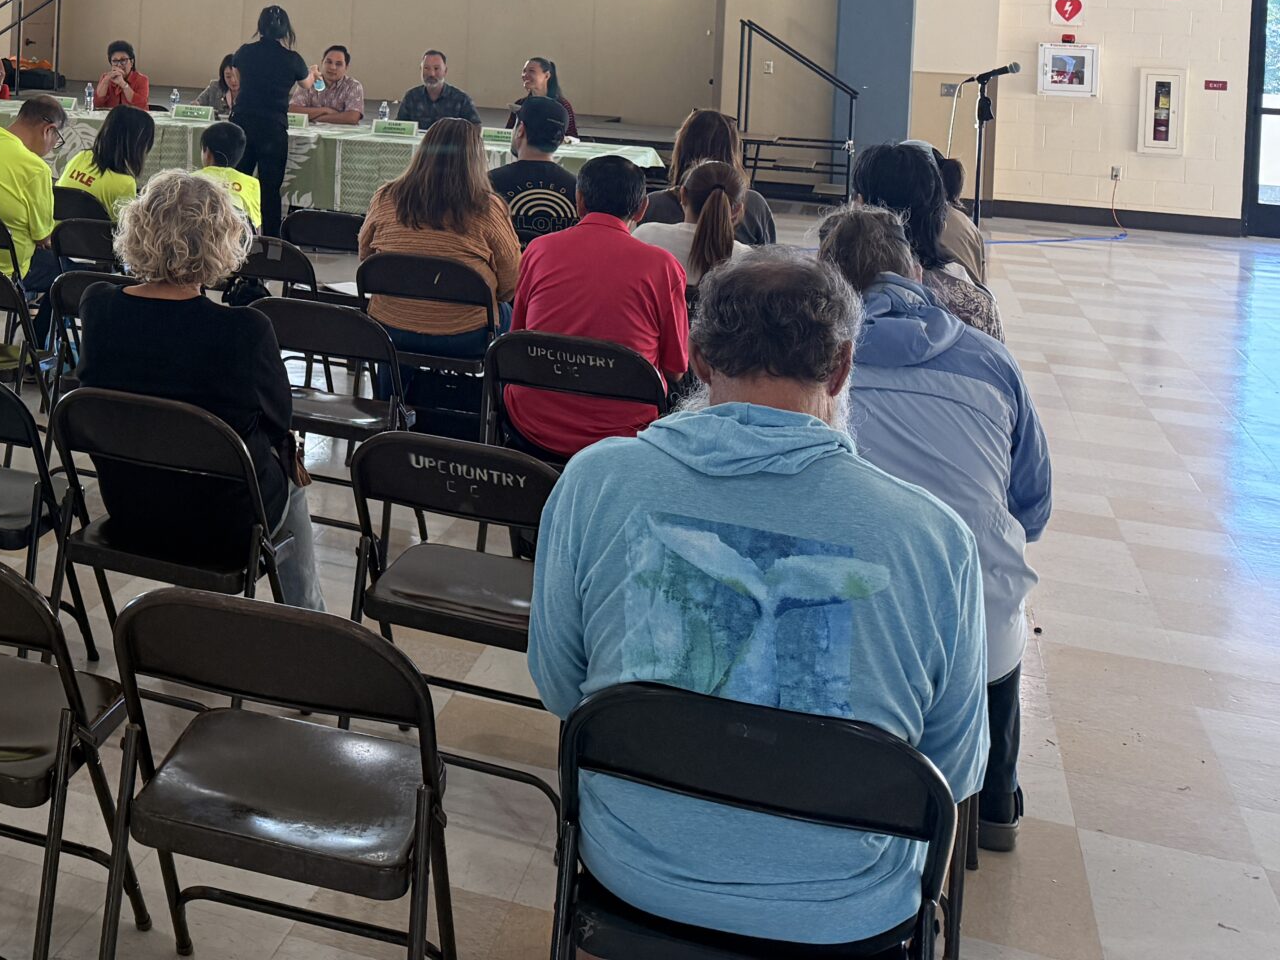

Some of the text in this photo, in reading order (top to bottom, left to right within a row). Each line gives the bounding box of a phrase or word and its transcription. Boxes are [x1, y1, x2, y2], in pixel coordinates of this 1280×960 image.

[69, 169, 96, 187] LYLE
[506, 181, 566, 198] DICTED
[527, 345, 615, 368] UPCOUNTRY
[408, 452, 527, 488] UPCOUNTRY
